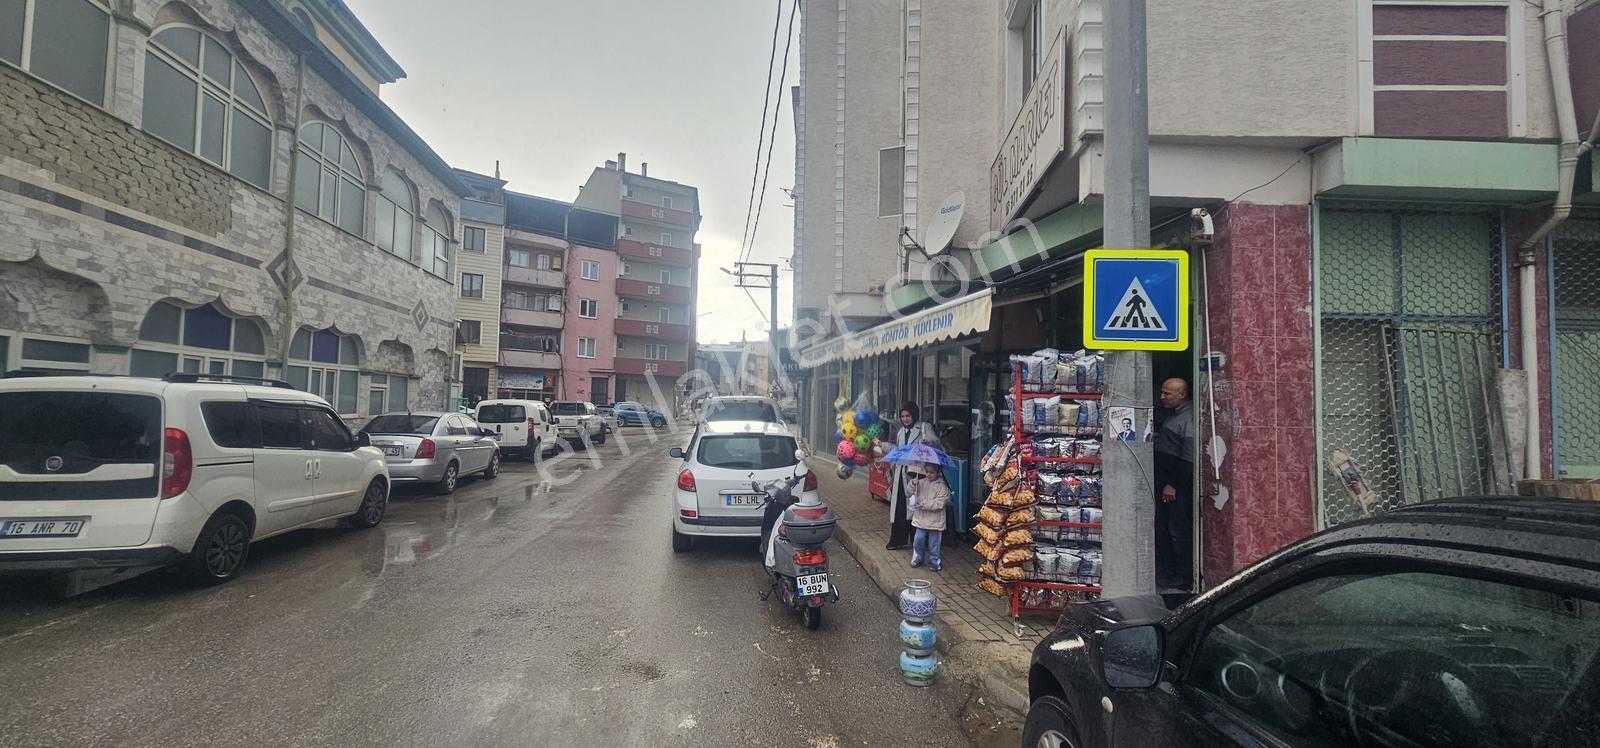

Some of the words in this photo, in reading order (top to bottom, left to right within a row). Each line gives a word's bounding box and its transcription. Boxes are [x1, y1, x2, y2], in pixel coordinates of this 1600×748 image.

[1009, 59, 1058, 185] MARKET
[733, 495, 743, 505] 16
[746, 495, 760, 505] LHL
[10, 522, 25, 535] 16
[31, 521, 56, 534] ANR
[62, 521, 80, 533] 70
[798, 577, 808, 586] 16
[810, 574, 827, 585] BUN
[806, 584, 823, 594] 992
